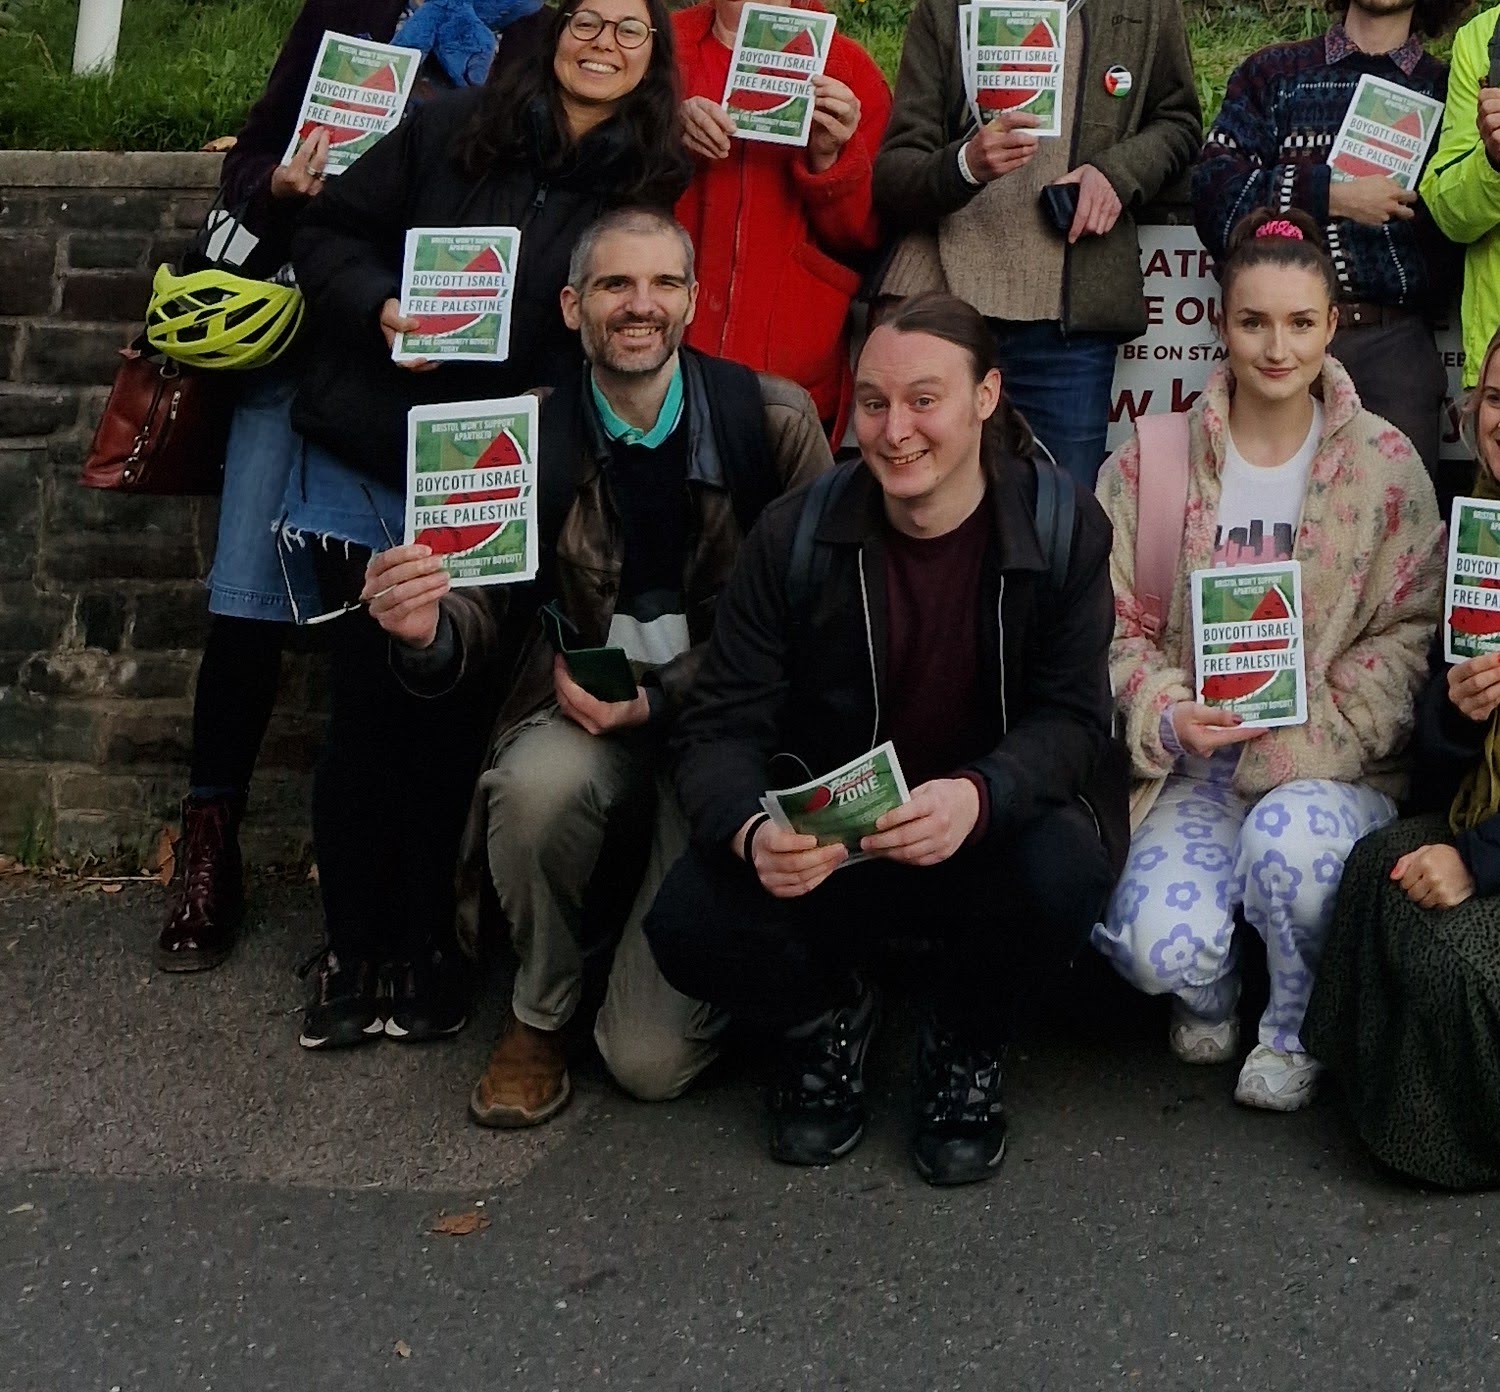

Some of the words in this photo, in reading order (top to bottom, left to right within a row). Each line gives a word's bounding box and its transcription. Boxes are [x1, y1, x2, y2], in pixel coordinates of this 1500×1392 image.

[740, 51, 782, 67] BOYCOTT
[783, 55, 817, 71] ISRAEL
[977, 50, 1022, 62] BOYCOTT
[1025, 50, 1058, 62] ISRAEL
[733, 75, 758, 88] FREE
[761, 78, 813, 95] PALESTINE
[977, 75, 1003, 87] FREE
[1004, 75, 1057, 87] PALESTINE
[314, 80, 361, 100] BOYCOTT
[361, 91, 398, 108] ISRAEL
[306, 105, 332, 122] FREE
[334, 109, 390, 131] PALESTINE
[1350, 118, 1392, 139] BOYCOTT
[1391, 131, 1422, 153] ISRAEL
[1341, 139, 1366, 155] FREE
[1367, 148, 1418, 174] PALESTINE
[1139, 249, 1215, 278] ATR
[413, 275, 463, 286] BOYCOTT
[467, 275, 507, 287] ISRAEL
[408, 300, 437, 312] FREE
[441, 300, 504, 312] PALESTINE
[1124, 345, 1148, 360] BE
[1154, 346, 1182, 360] ON
[1188, 346, 1229, 360] STA
[416, 474, 476, 493] BOYCOTT
[481, 469, 528, 487] ISRAEL
[415, 511, 448, 527] FREE
[454, 502, 527, 525] PALESTINE
[1453, 589, 1480, 606] FREE
[1203, 625, 1253, 642] BOYCOTT
[1257, 621, 1296, 637] ISRAEL
[1203, 657, 1231, 673] FREE
[1236, 652, 1295, 671] PALESTINE
[836, 775, 880, 806] ZONE
